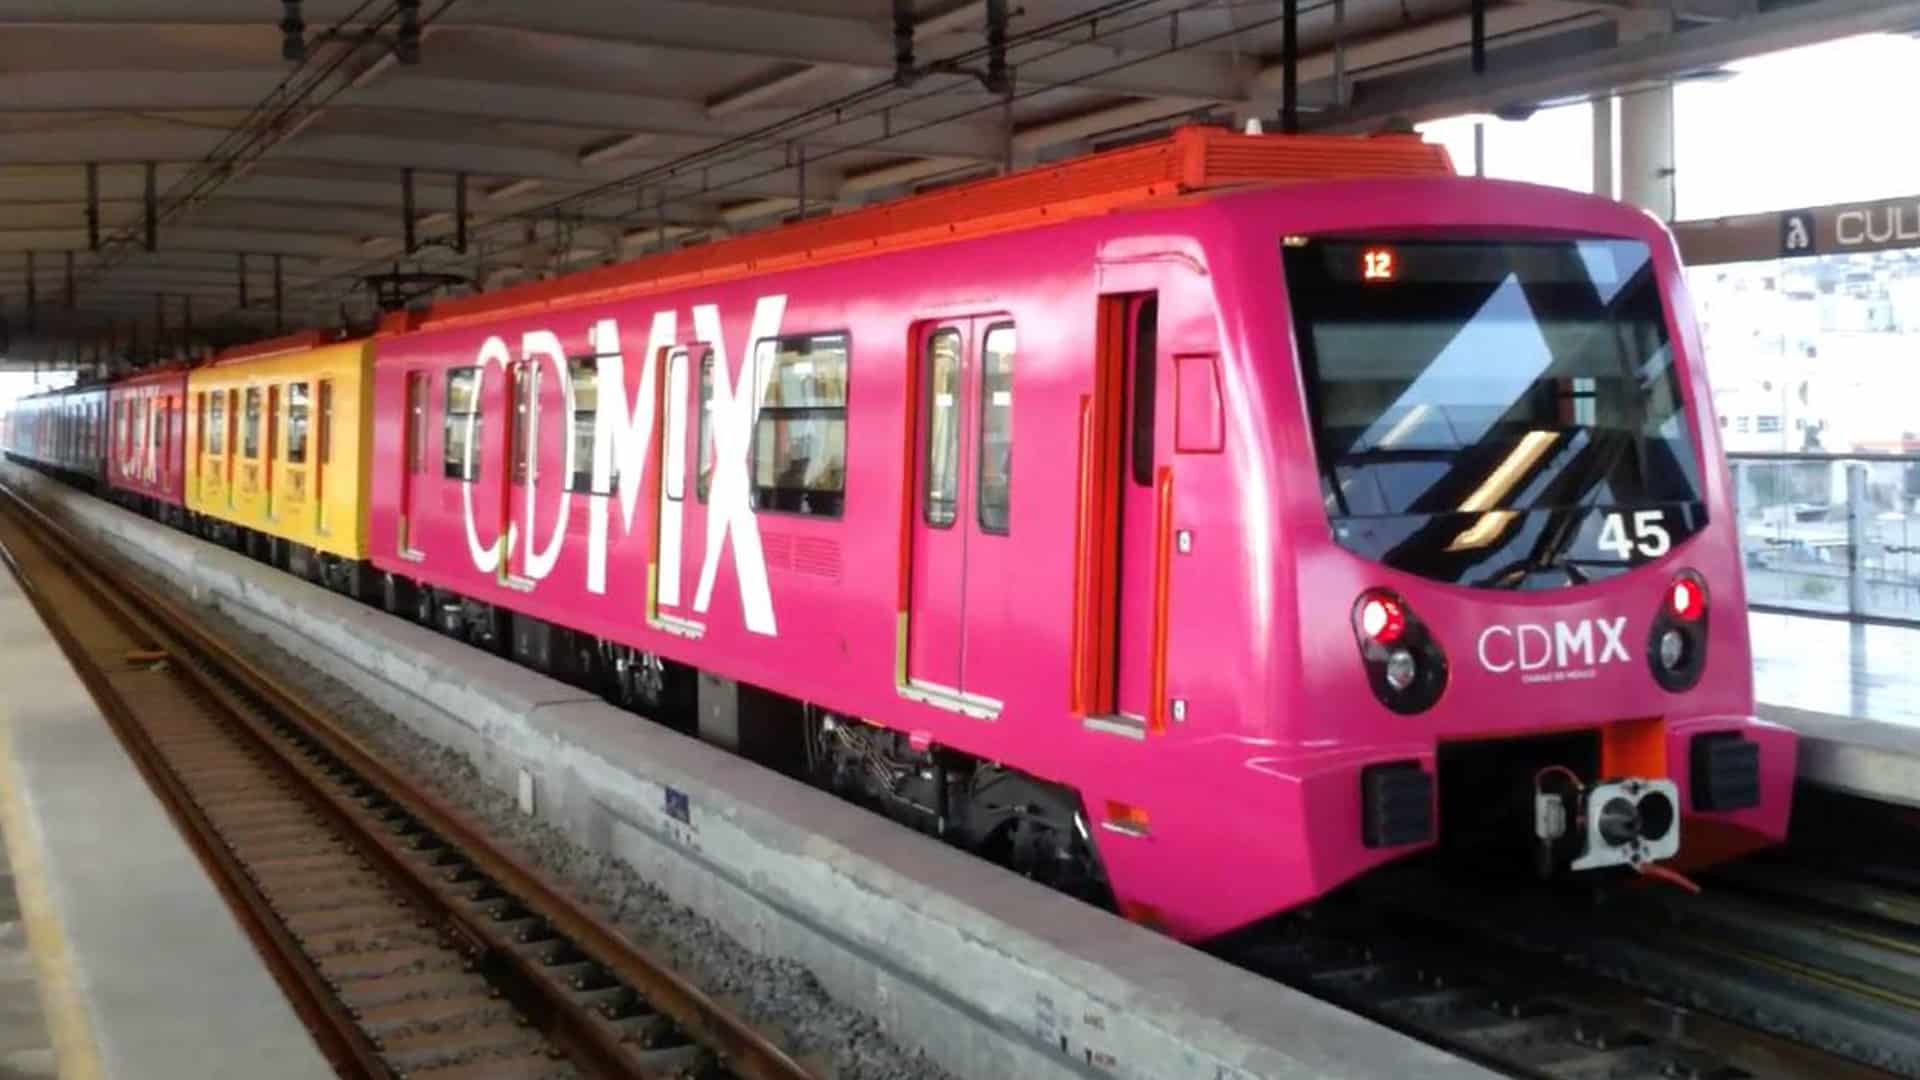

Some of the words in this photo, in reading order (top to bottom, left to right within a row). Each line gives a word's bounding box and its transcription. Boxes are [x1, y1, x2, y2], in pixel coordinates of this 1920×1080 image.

[1836, 205, 1920, 244] CUL
[1365, 252, 1391, 278] 12
[463, 294, 788, 636] CDMX
[1597, 510, 1671, 560] 45
[1477, 616, 1631, 673] CDMX
